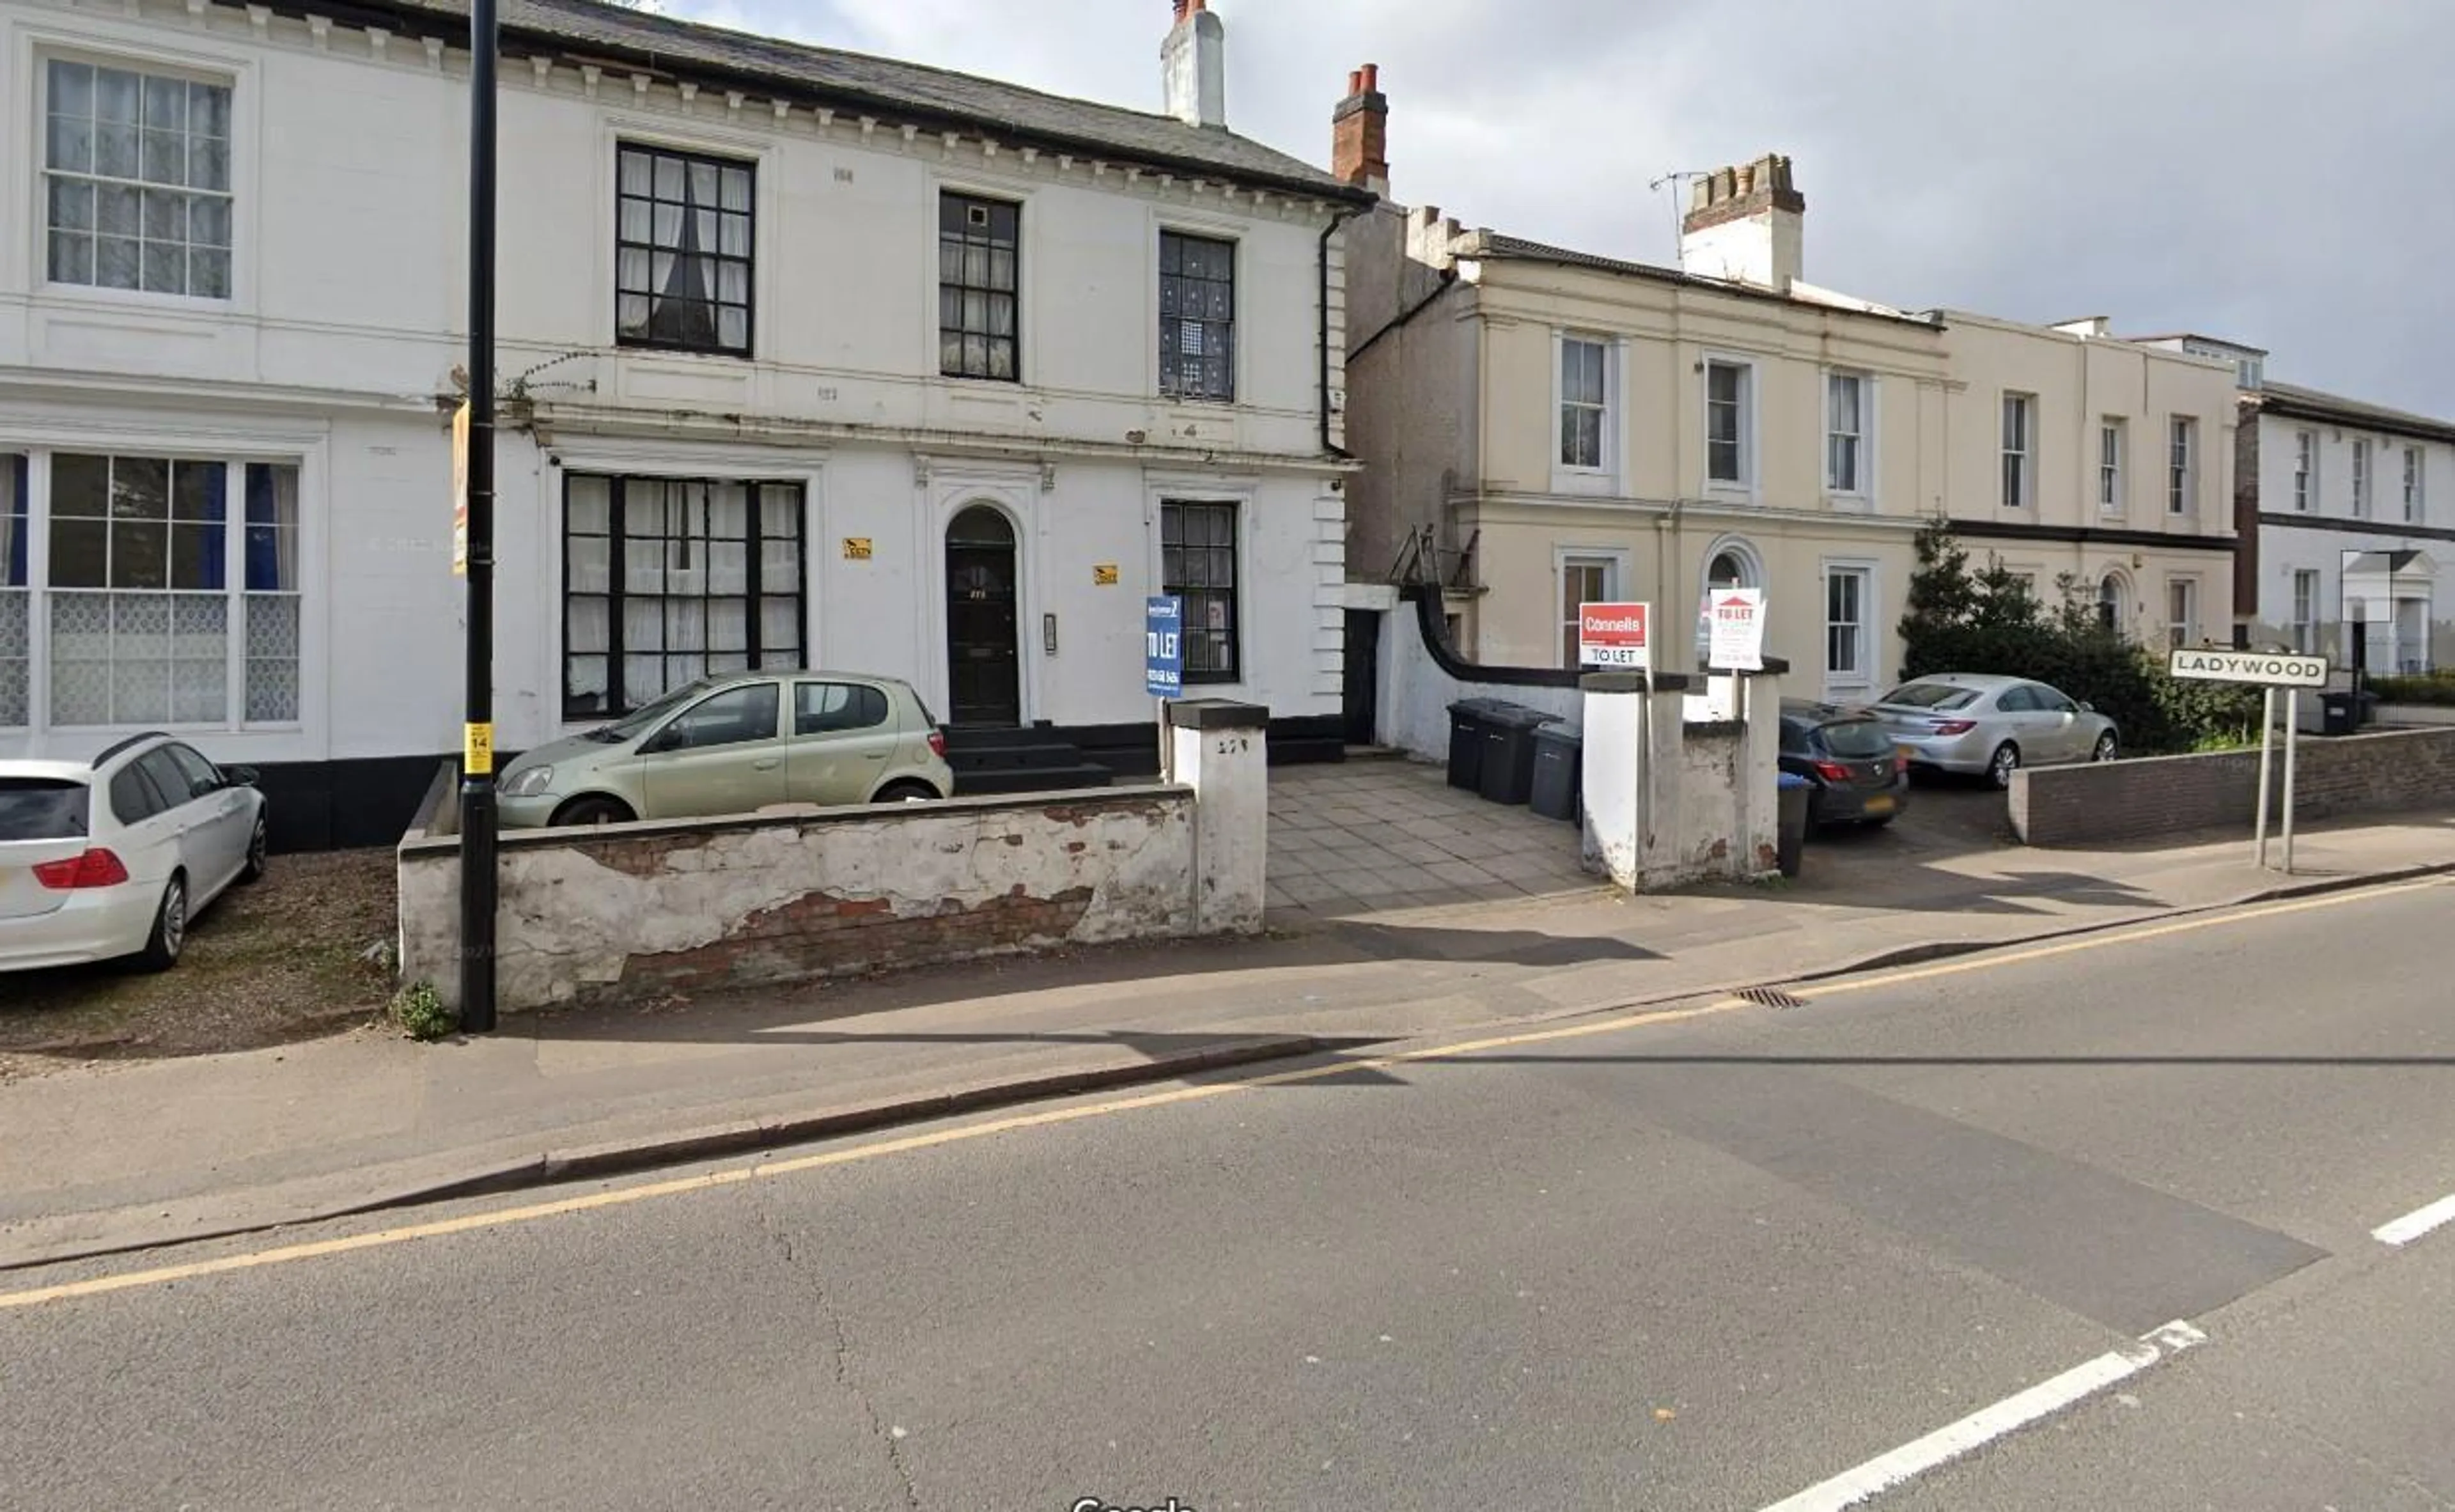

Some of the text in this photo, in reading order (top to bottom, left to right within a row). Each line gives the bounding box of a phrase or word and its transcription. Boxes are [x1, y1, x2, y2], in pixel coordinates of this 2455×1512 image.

[1718, 609, 1754, 620] TO LET
[1586, 616, 1639, 632] Connells
[1591, 649, 1636, 662] TO LET
[2178, 657, 2320, 678] LADYWOOD
[472, 737, 488, 749] 14
